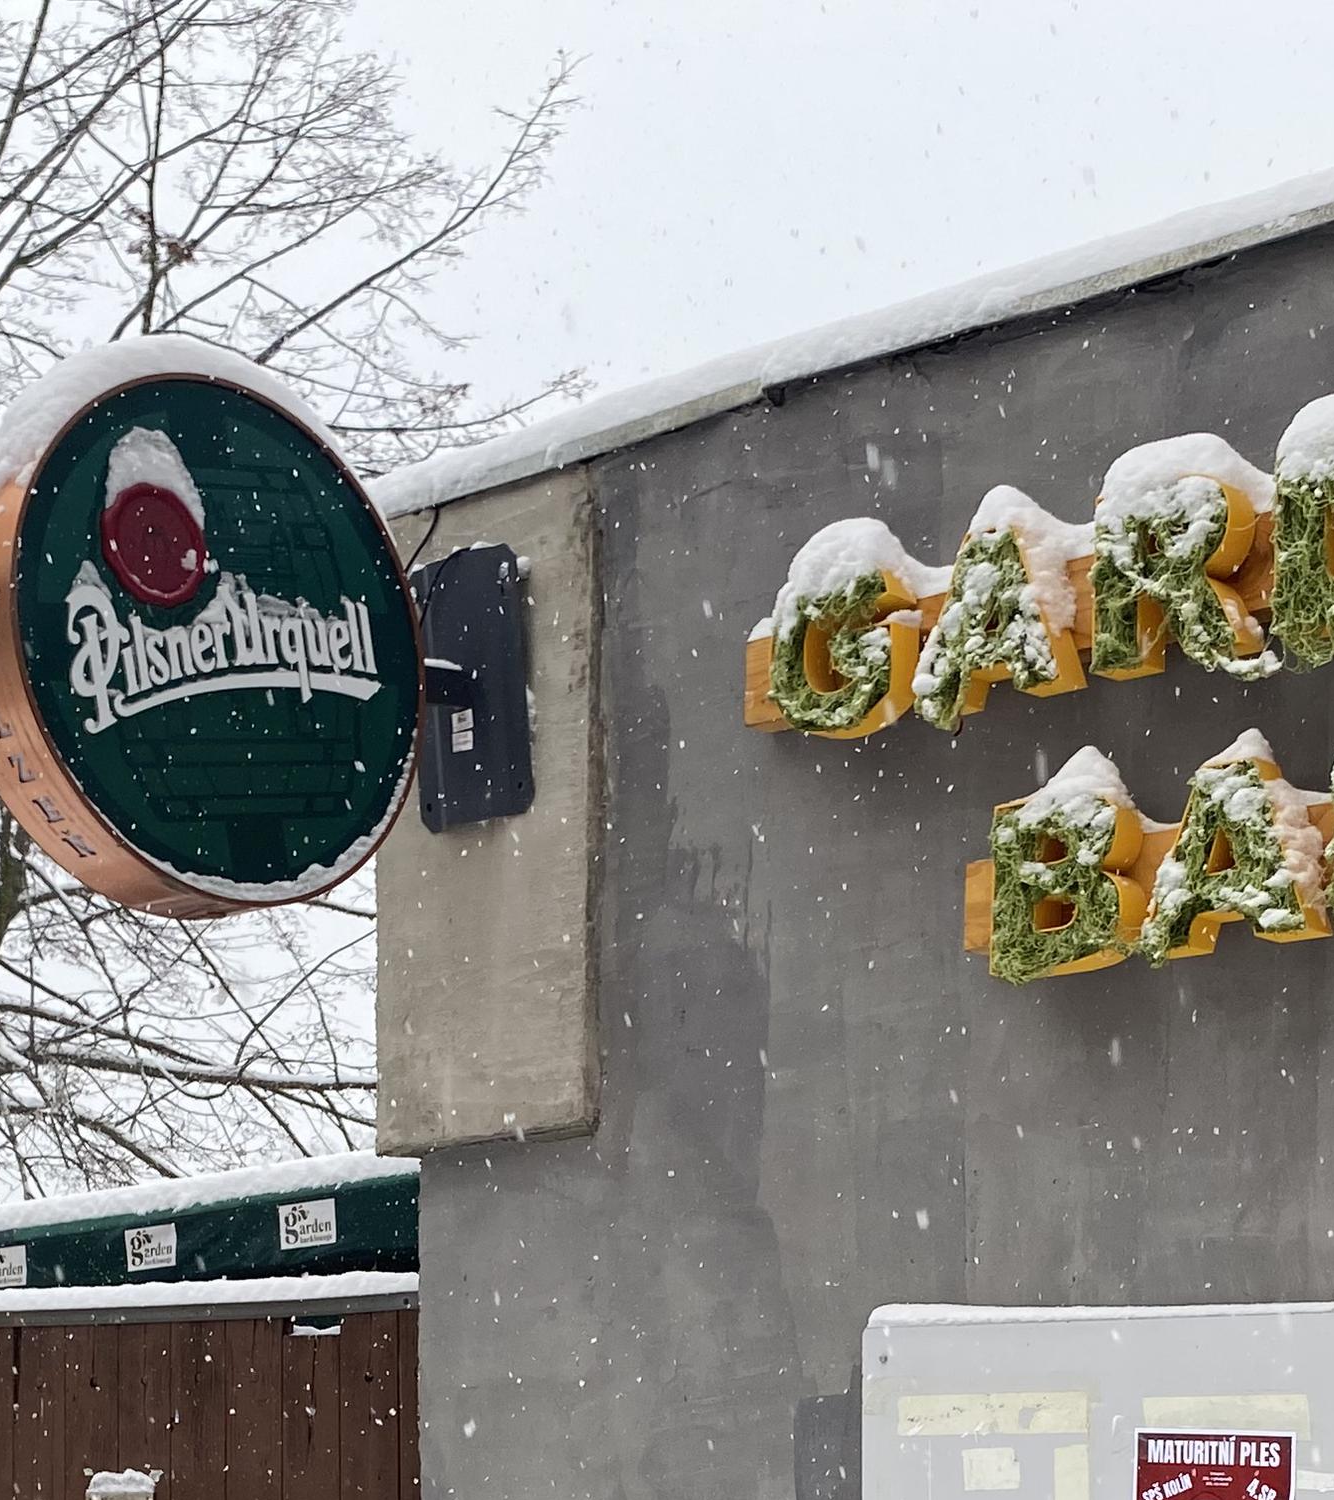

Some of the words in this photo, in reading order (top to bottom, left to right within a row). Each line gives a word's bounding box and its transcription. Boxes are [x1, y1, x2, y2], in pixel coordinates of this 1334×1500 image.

[65, 584, 232, 734] Pilsner
[215, 582, 379, 703] Urquell
[284, 1208, 332, 1245] garden
[130, 1232, 173, 1267] garden
[1147, 1435, 1236, 1466] MATURITNÍ
[1238, 1441, 1281, 1468] PLES
[1162, 1472, 1193, 1499] KOLÍN
